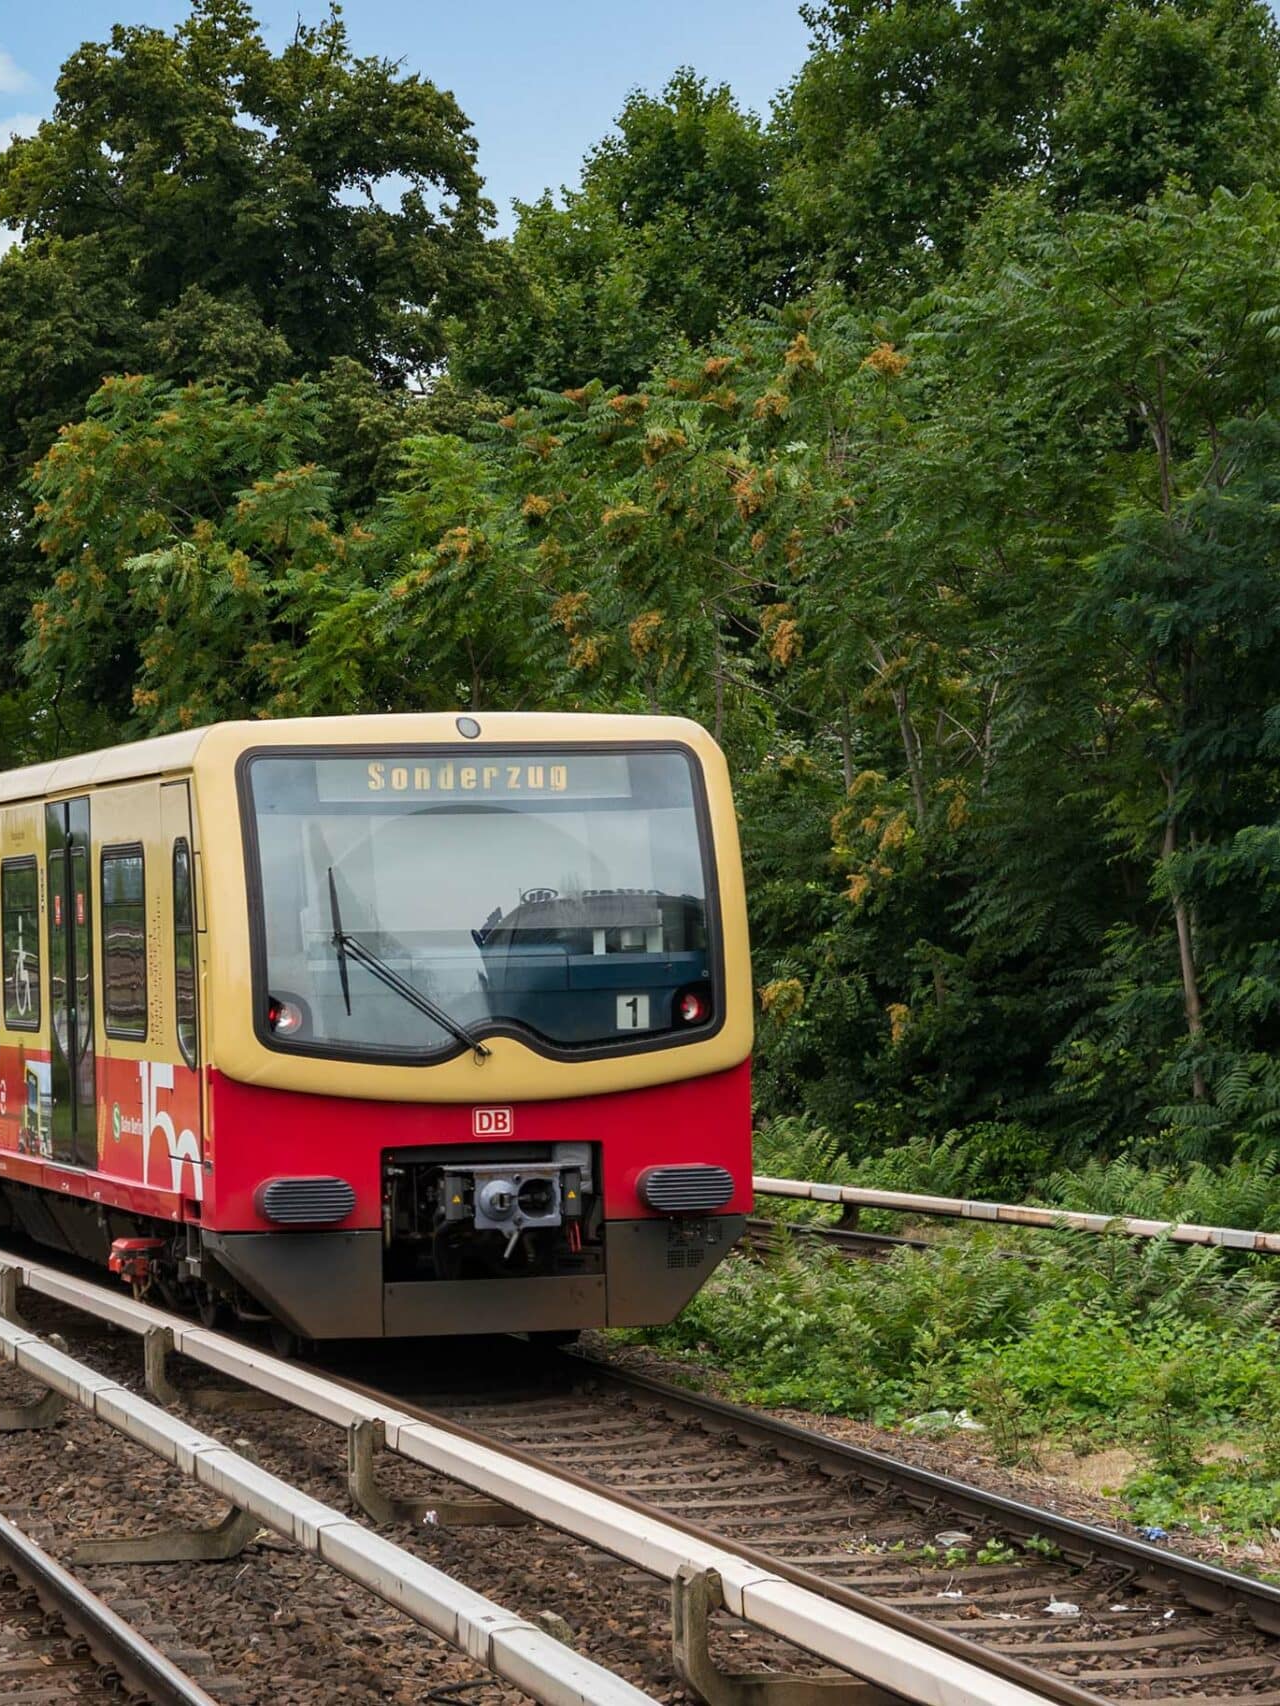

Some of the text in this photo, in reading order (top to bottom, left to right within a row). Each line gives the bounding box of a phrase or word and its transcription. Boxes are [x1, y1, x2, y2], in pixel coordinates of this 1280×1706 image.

[368, 762, 568, 791] Sonderzug
[625, 997, 638, 1028] 1
[478, 1111, 508, 1131] DB
